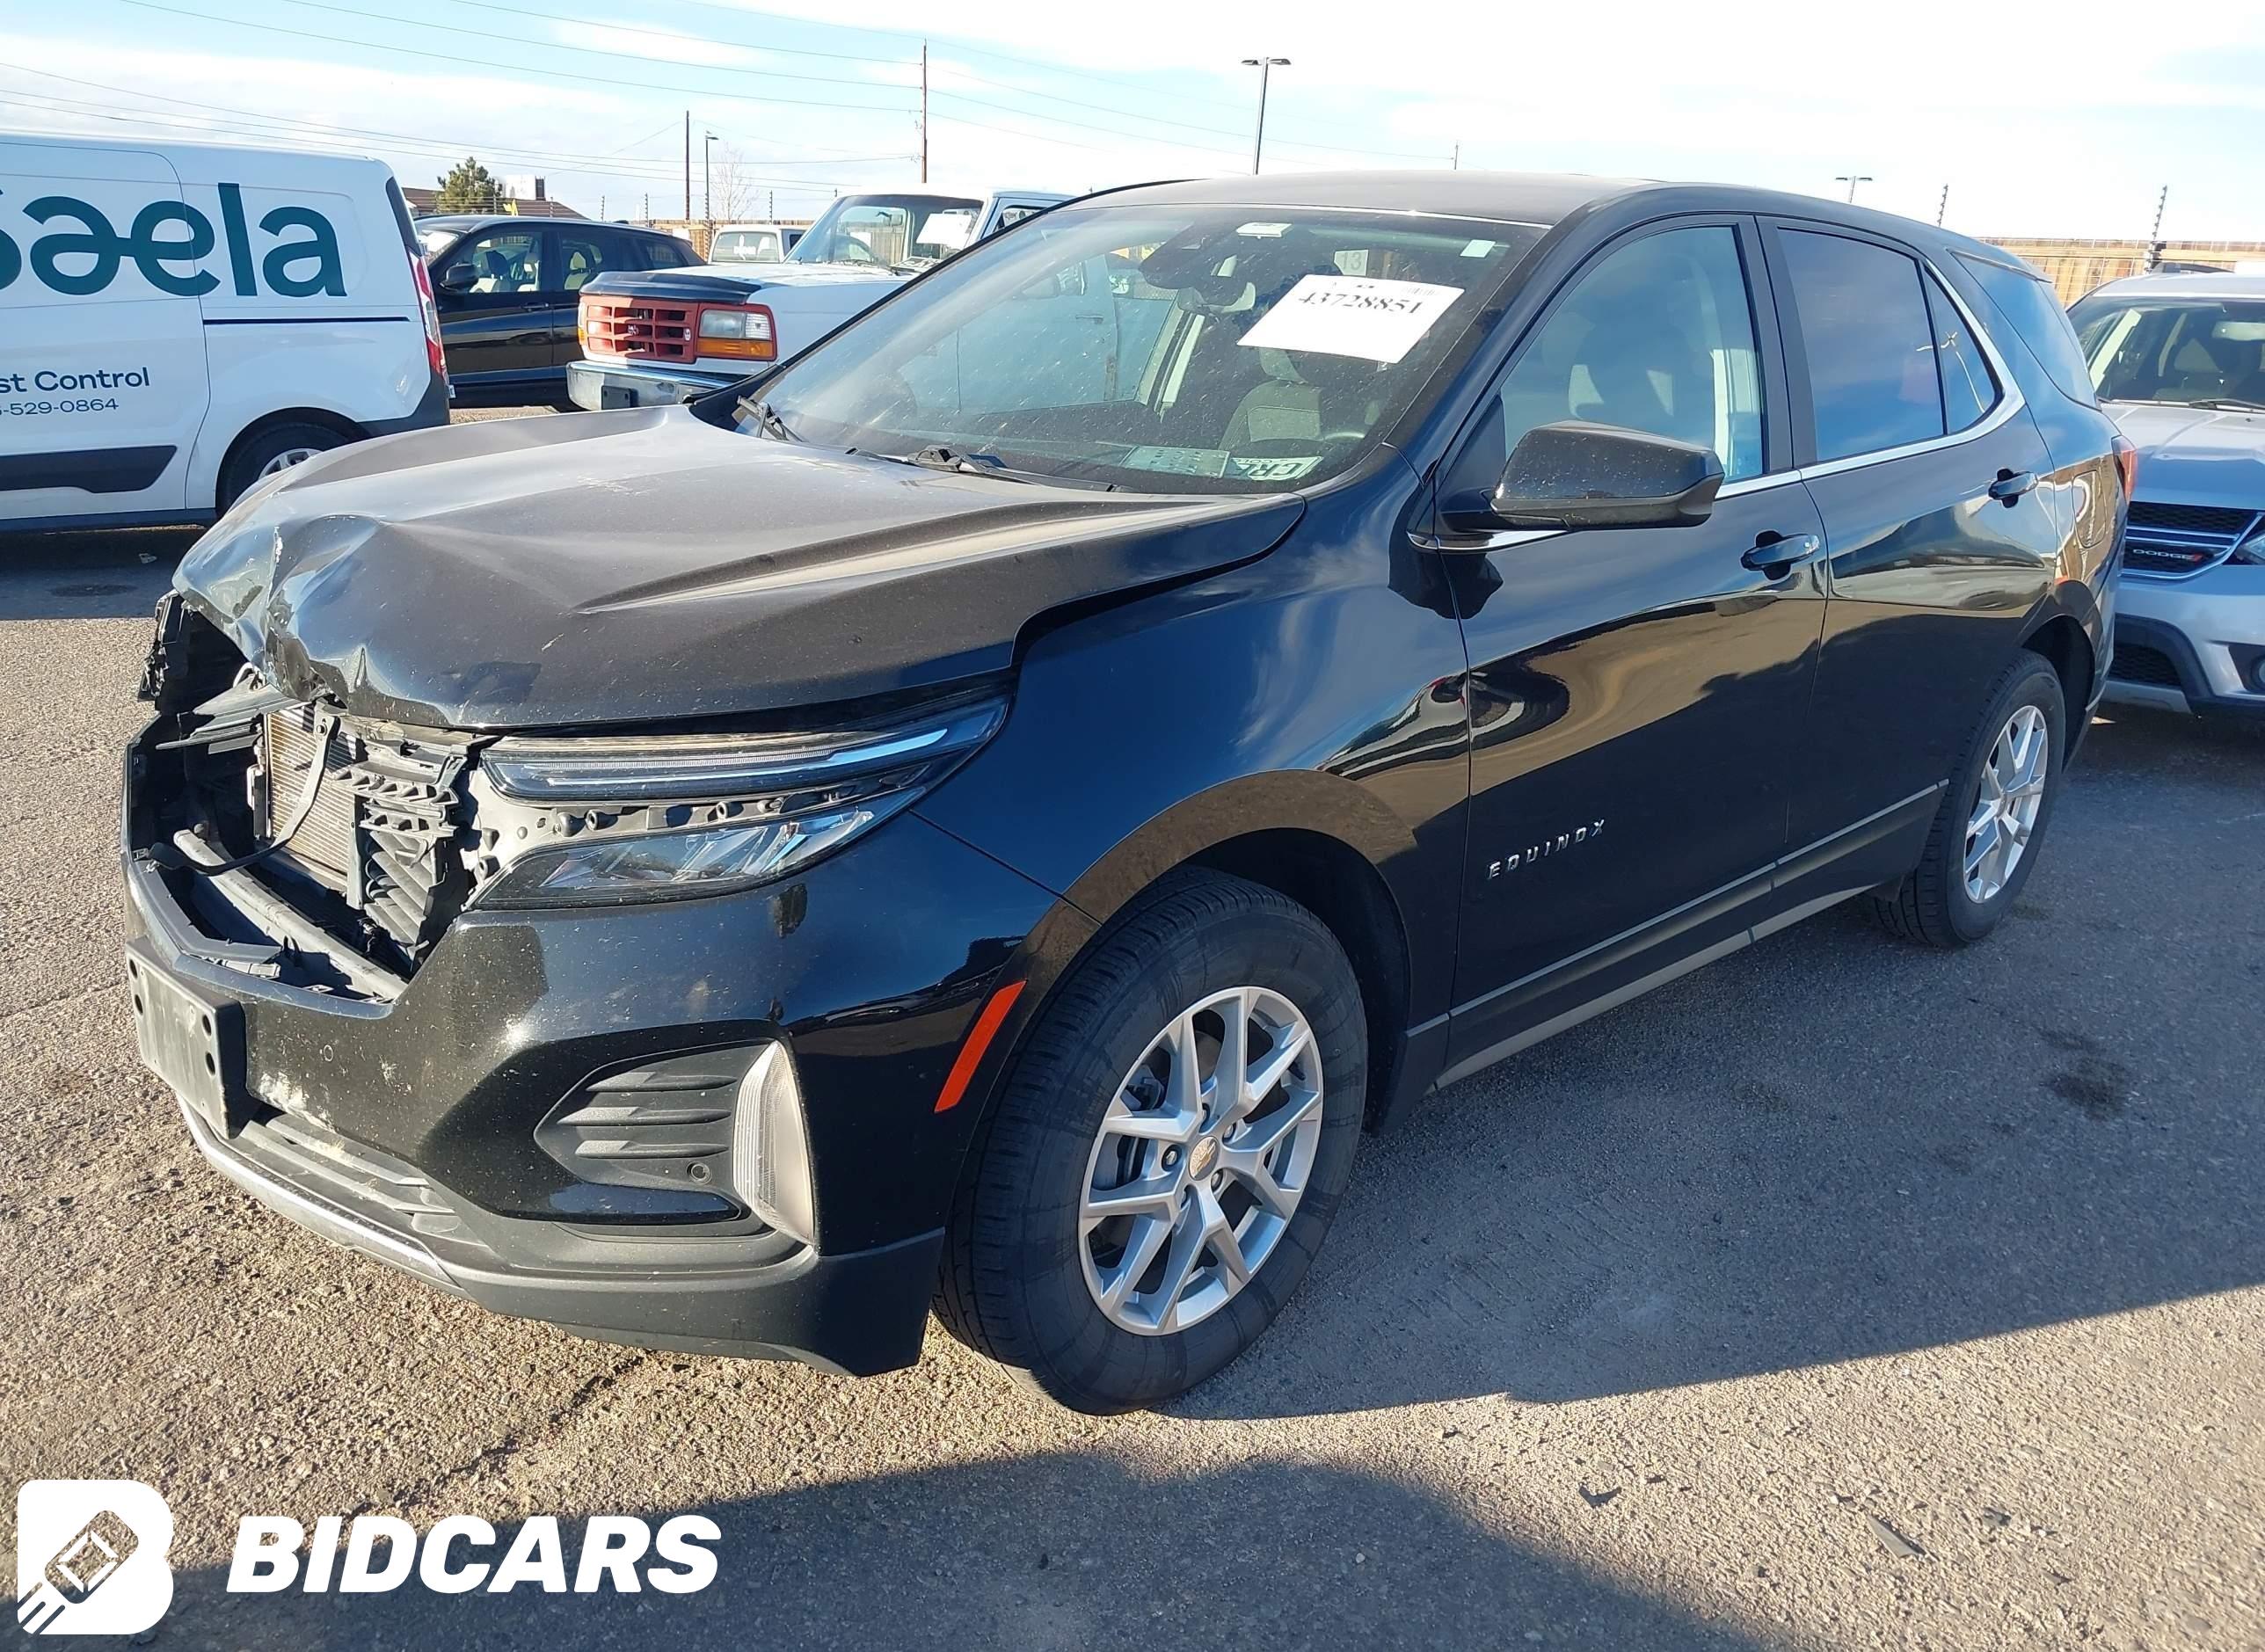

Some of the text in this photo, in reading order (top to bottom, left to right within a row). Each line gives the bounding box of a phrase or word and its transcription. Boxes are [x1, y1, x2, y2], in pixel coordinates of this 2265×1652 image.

[0, 183, 347, 296] aela
[34, 367, 150, 391] Control
[0, 398, 119, 416] -529-0864
[2132, 549, 2196, 561] DODGE
[1488, 819, 1605, 879] EQUINOX
